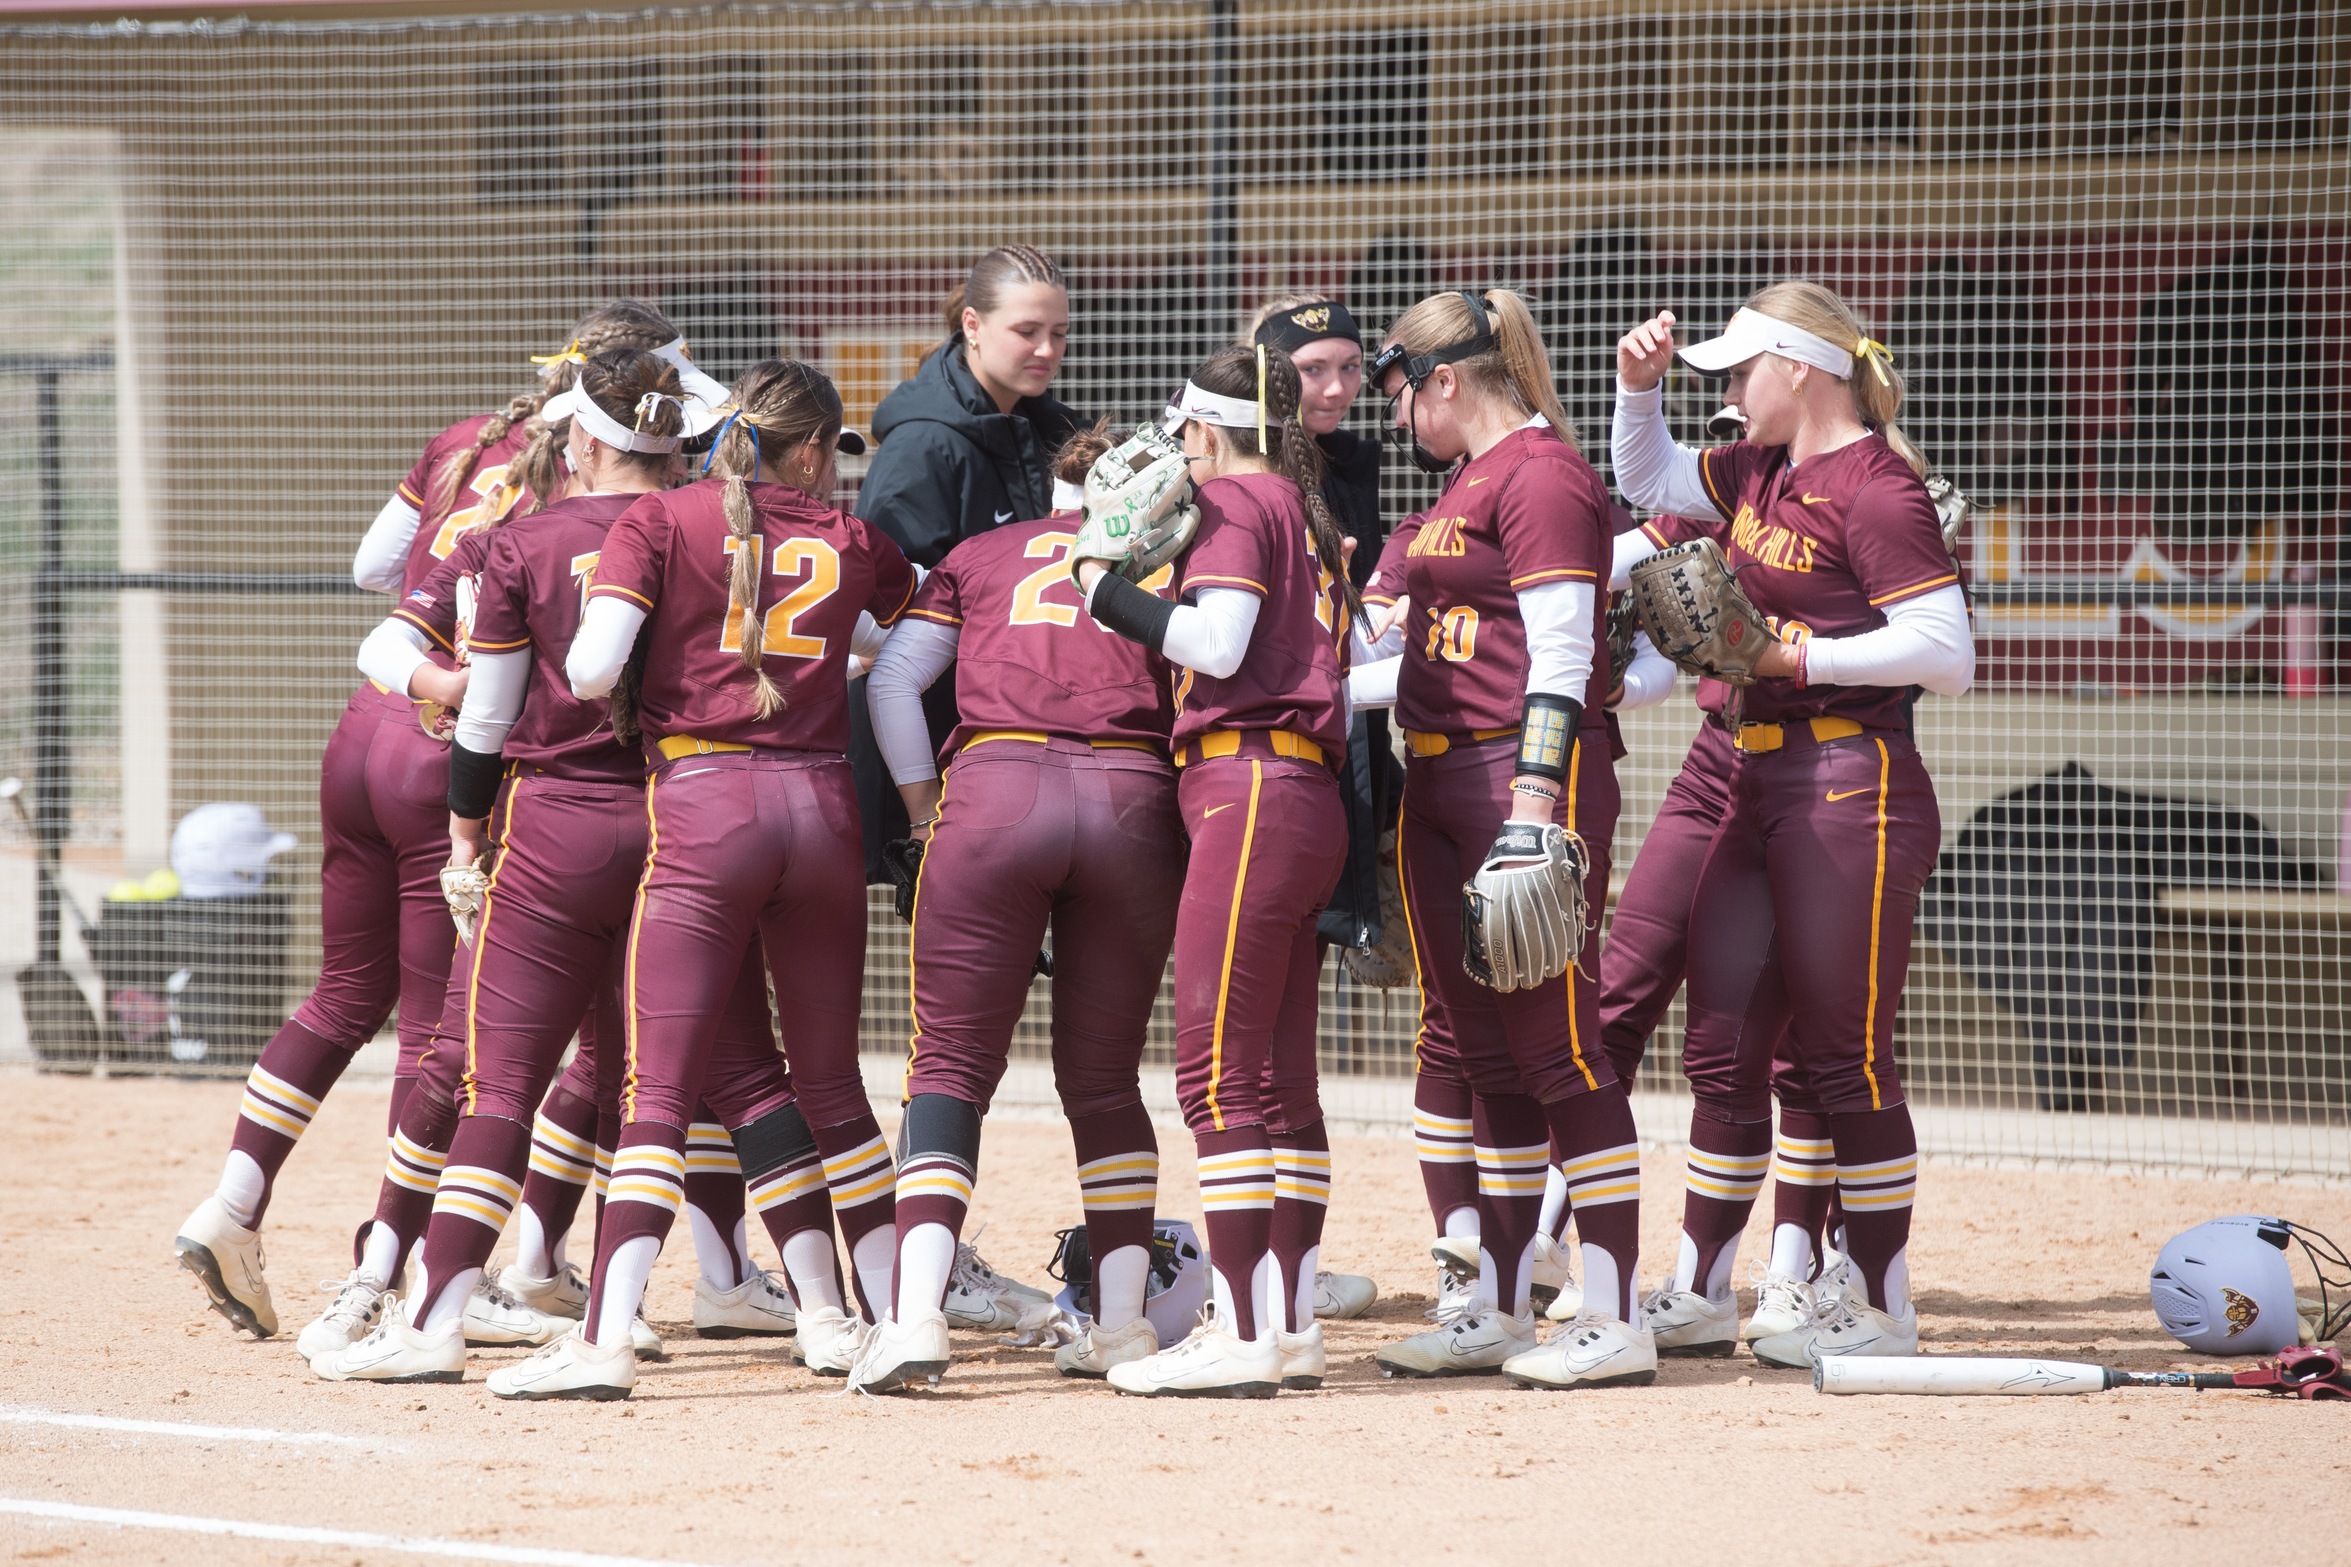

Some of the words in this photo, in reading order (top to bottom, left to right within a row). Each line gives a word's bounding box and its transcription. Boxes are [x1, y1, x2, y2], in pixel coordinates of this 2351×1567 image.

[1103, 514, 1131, 538] W
[1757, 526, 1818, 573] HILLS
[719, 534, 841, 660] 12
[1425, 605, 1479, 662] 10
[1493, 938, 1508, 974] A1000
[2159, 1374, 2187, 1384] CRBN
